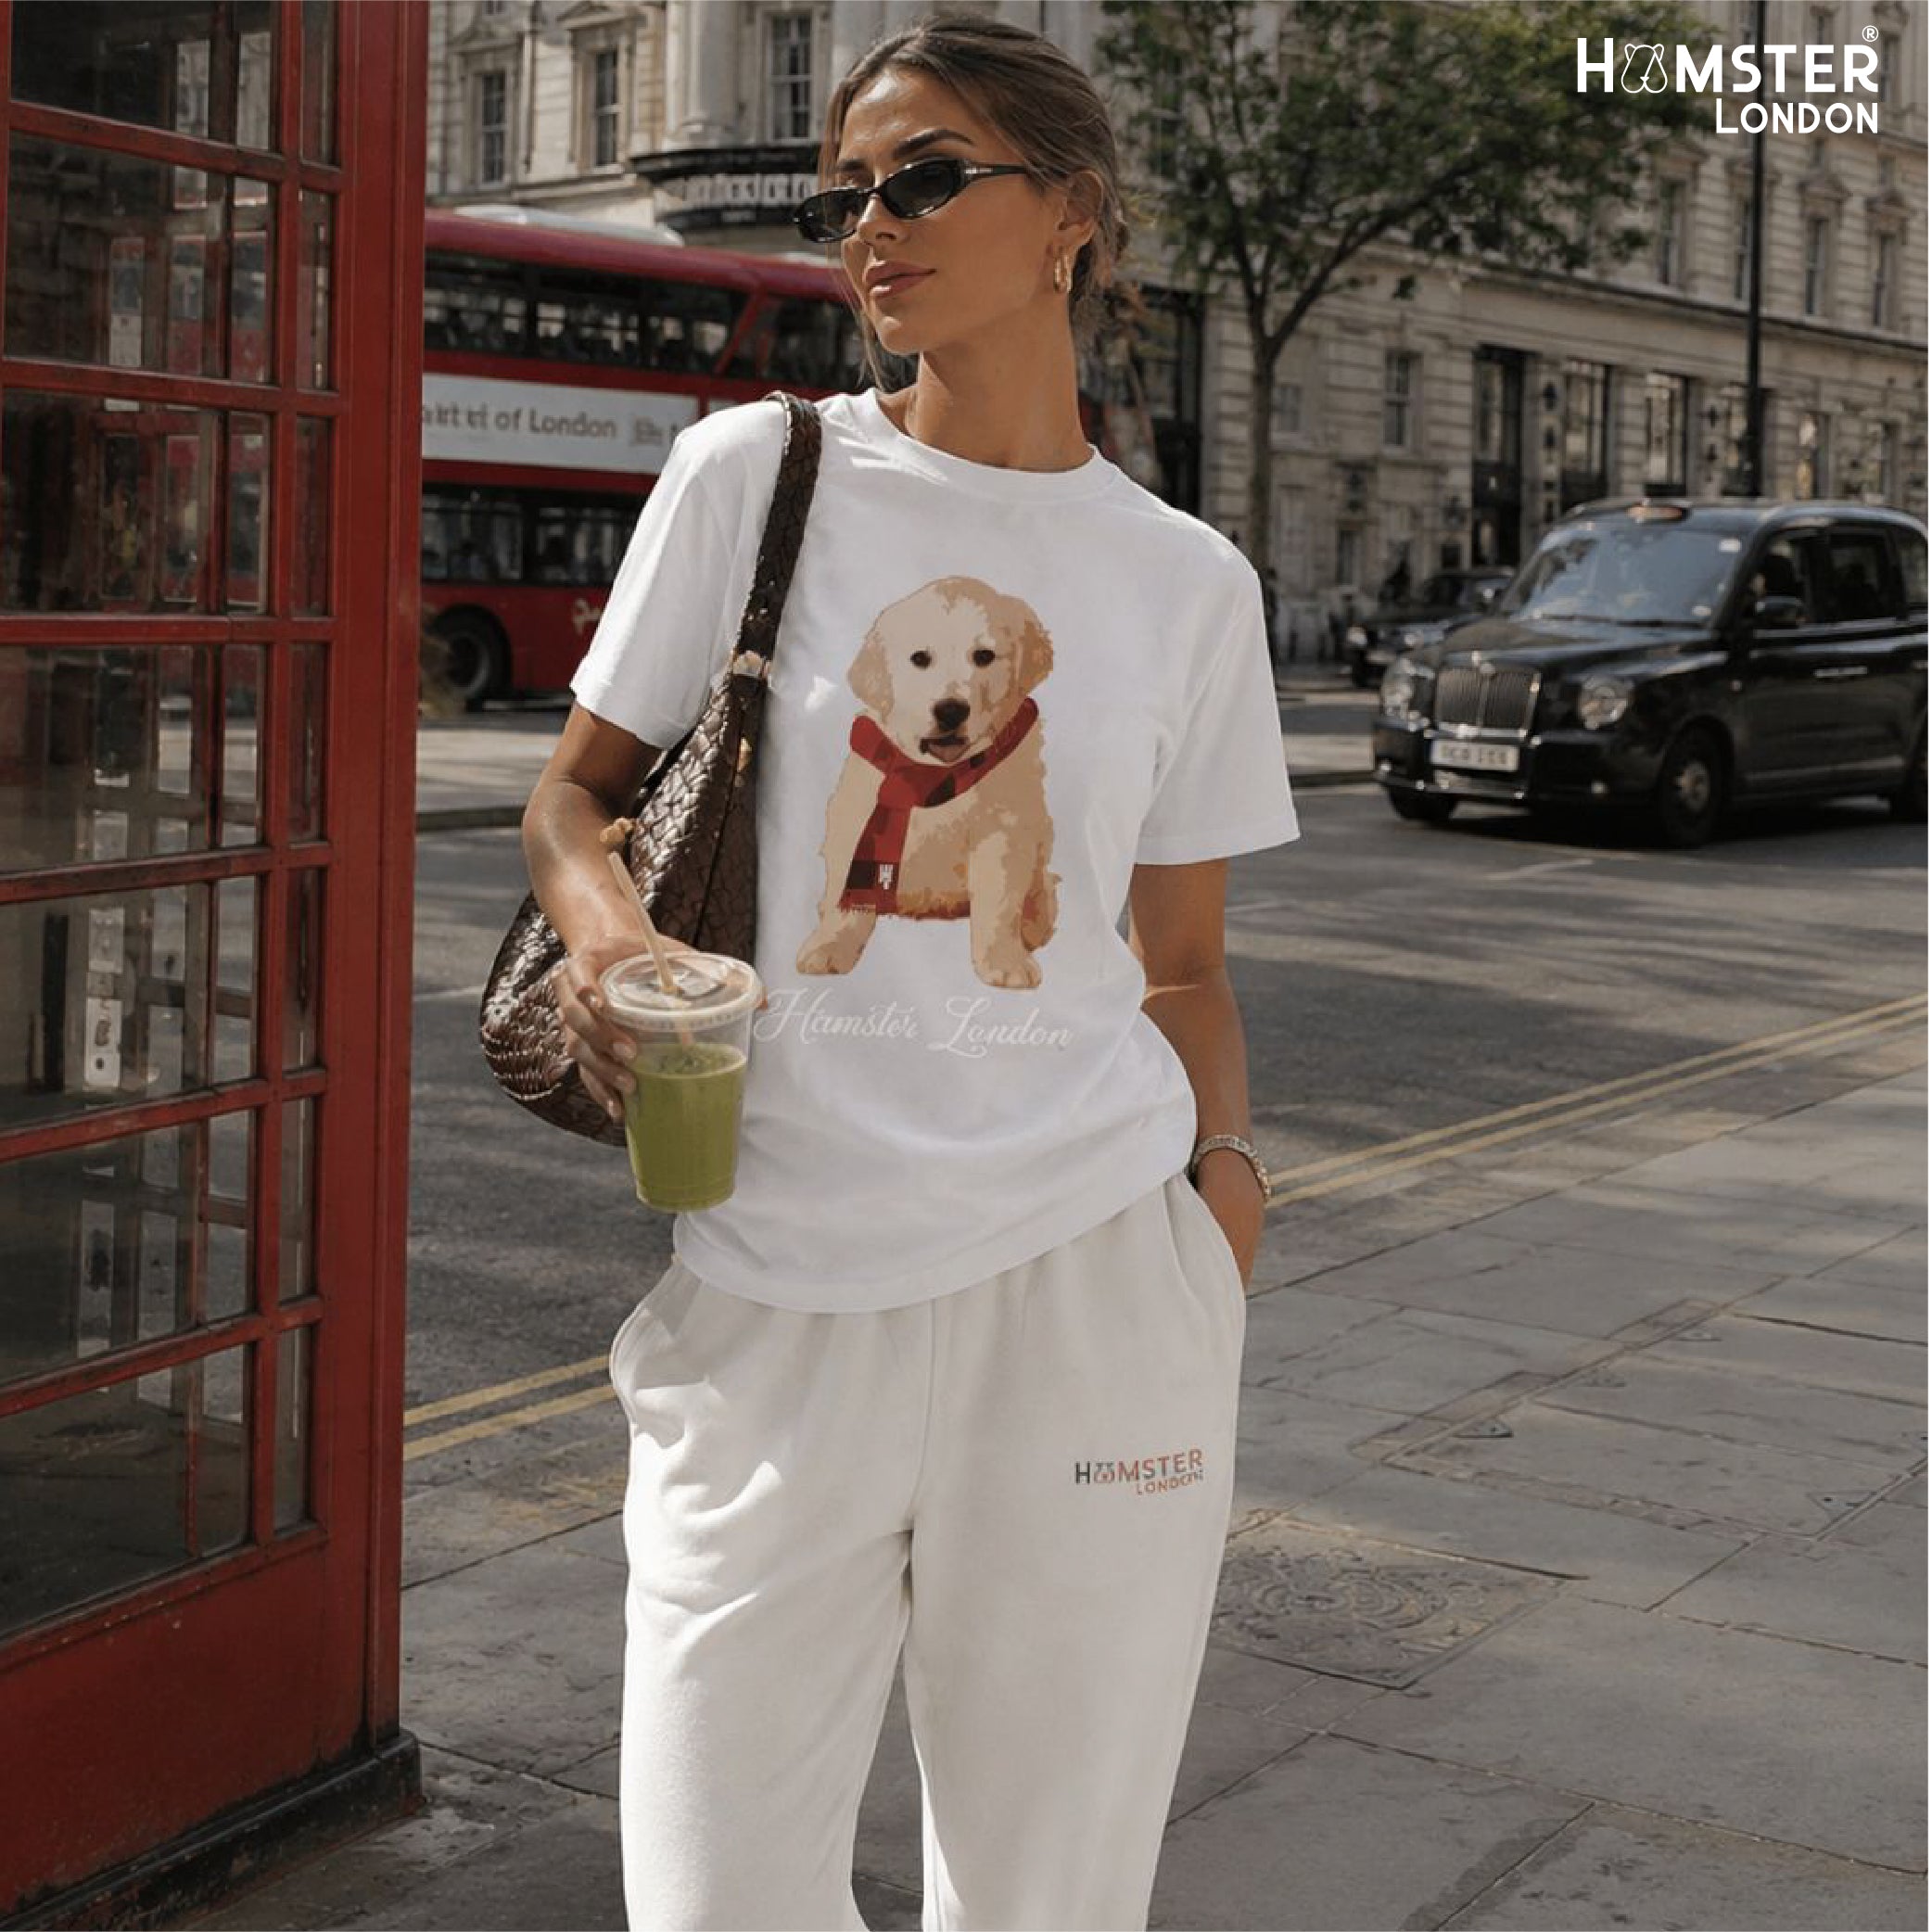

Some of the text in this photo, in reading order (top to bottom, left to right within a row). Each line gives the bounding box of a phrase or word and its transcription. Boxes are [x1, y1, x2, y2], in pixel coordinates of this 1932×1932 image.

[494, 408, 522, 431] of
[528, 408, 617, 439] London
[928, 995, 1074, 1059] London
